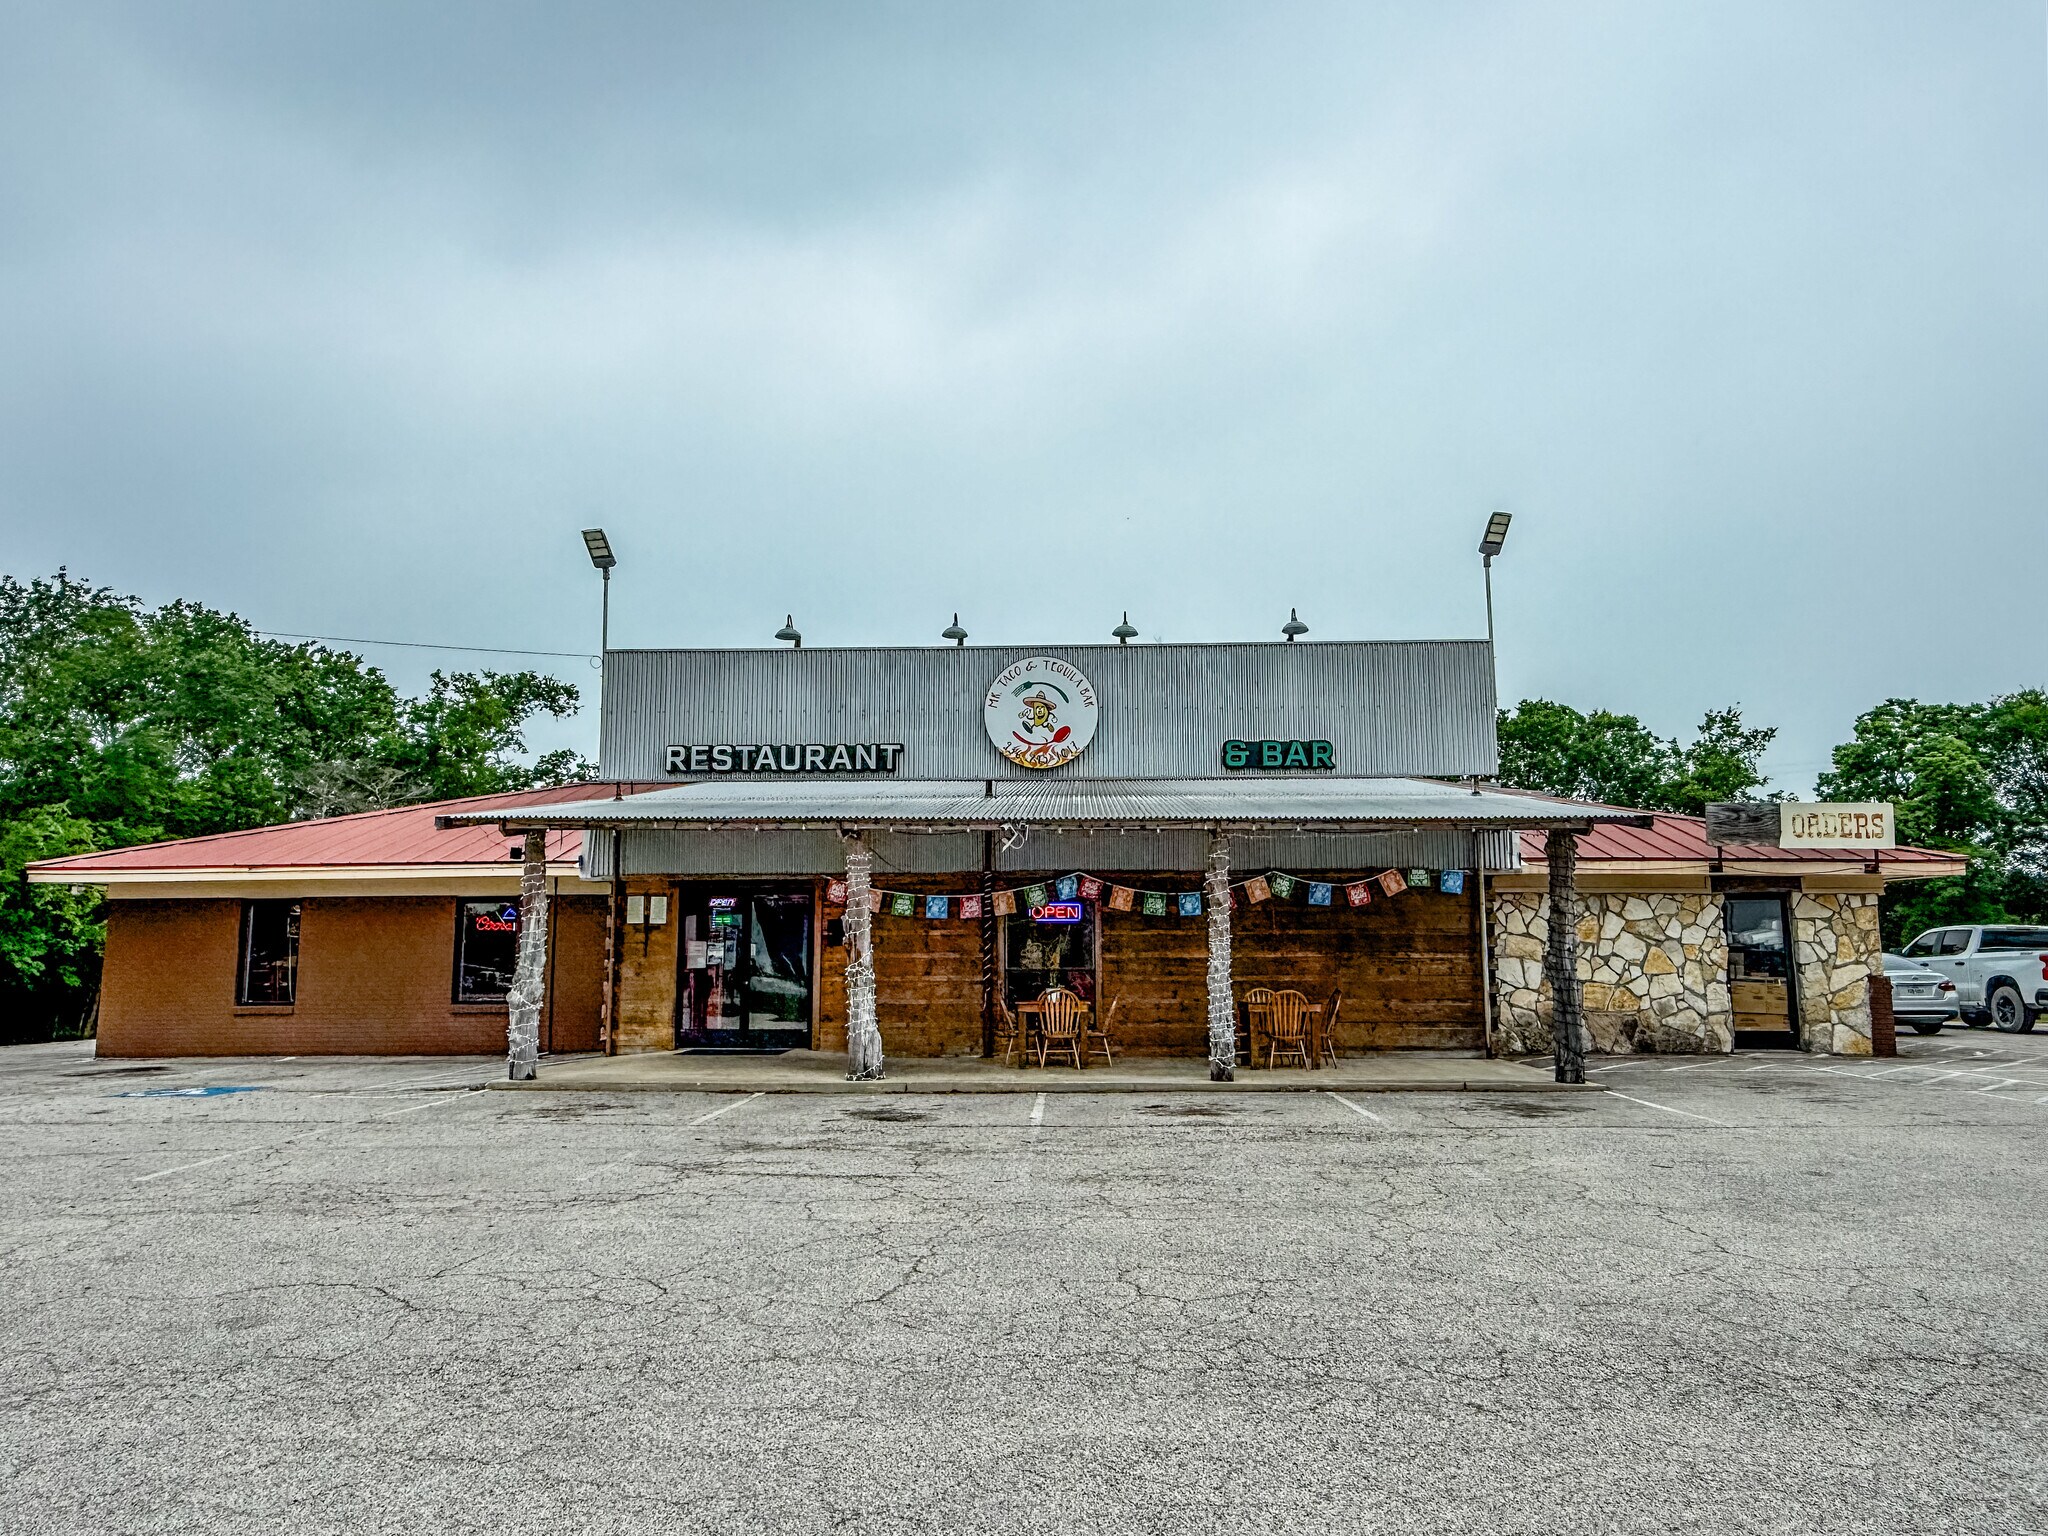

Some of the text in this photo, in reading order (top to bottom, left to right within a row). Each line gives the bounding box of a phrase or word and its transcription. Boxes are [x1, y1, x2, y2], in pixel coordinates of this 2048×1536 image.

[997, 665, 1021, 687] TACO
[1025, 660, 1038, 671] &
[1043, 660, 1084, 688] TEQUILA
[1079, 687, 1095, 708] BAR
[665, 743, 903, 772] RESTAURANT
[1224, 740, 1336, 768] & BAR
[1791, 812, 1885, 839] ORDERS
[708, 897, 737, 907] OPEN
[1031, 905, 1078, 919] OPEN
